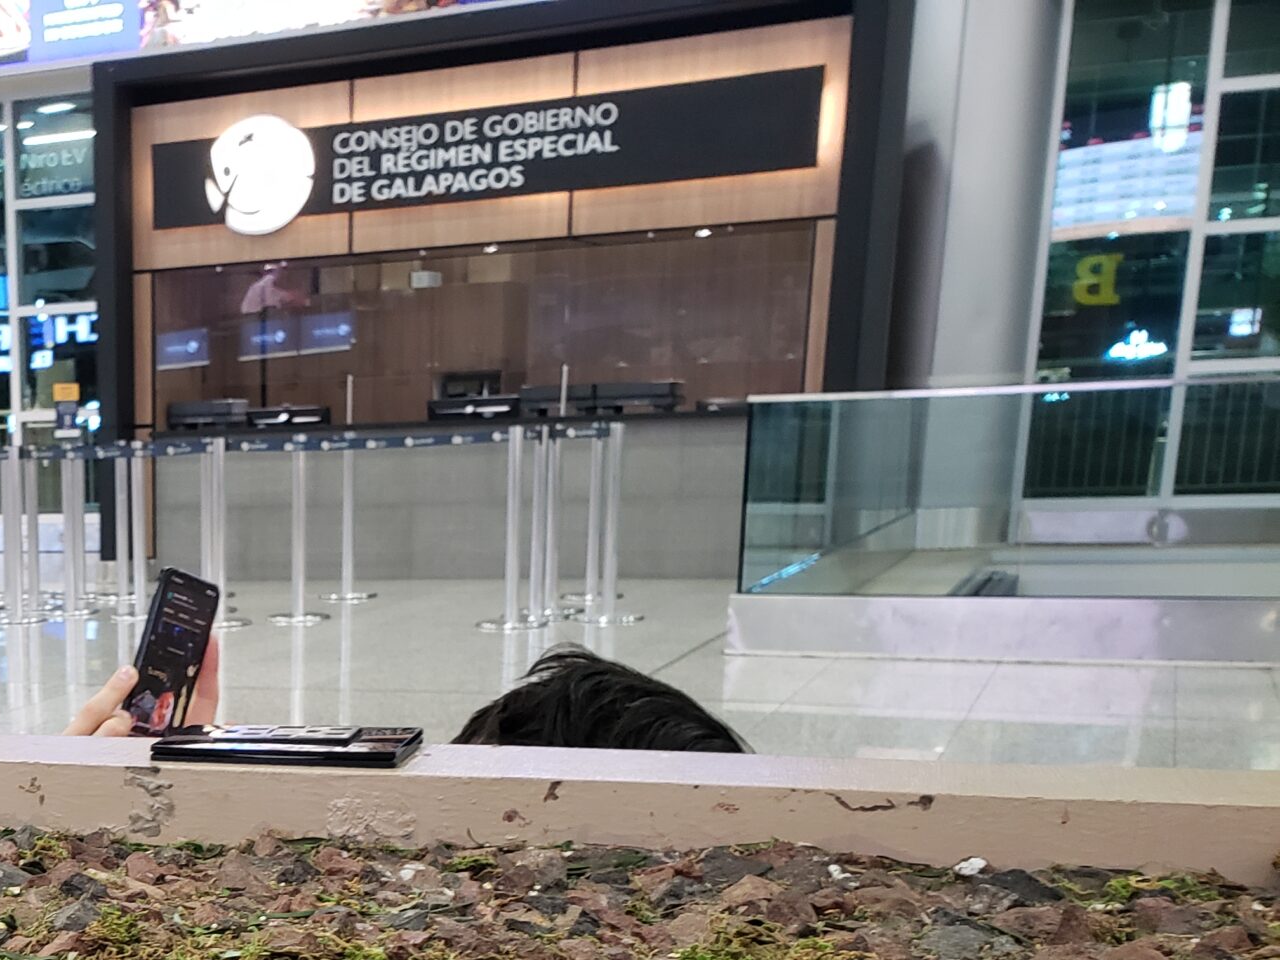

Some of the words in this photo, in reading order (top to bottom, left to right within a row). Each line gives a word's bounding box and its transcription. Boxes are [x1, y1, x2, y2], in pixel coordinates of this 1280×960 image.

[333, 123, 439, 154] CONSEJO
[444, 117, 479, 143] DE
[483, 102, 619, 138] GOBIERNO
[333, 156, 376, 179] DEL
[498, 130, 620, 163] ESPECIAL
[333, 182, 367, 204] DE
[371, 165, 525, 200] GALAPAGOS
